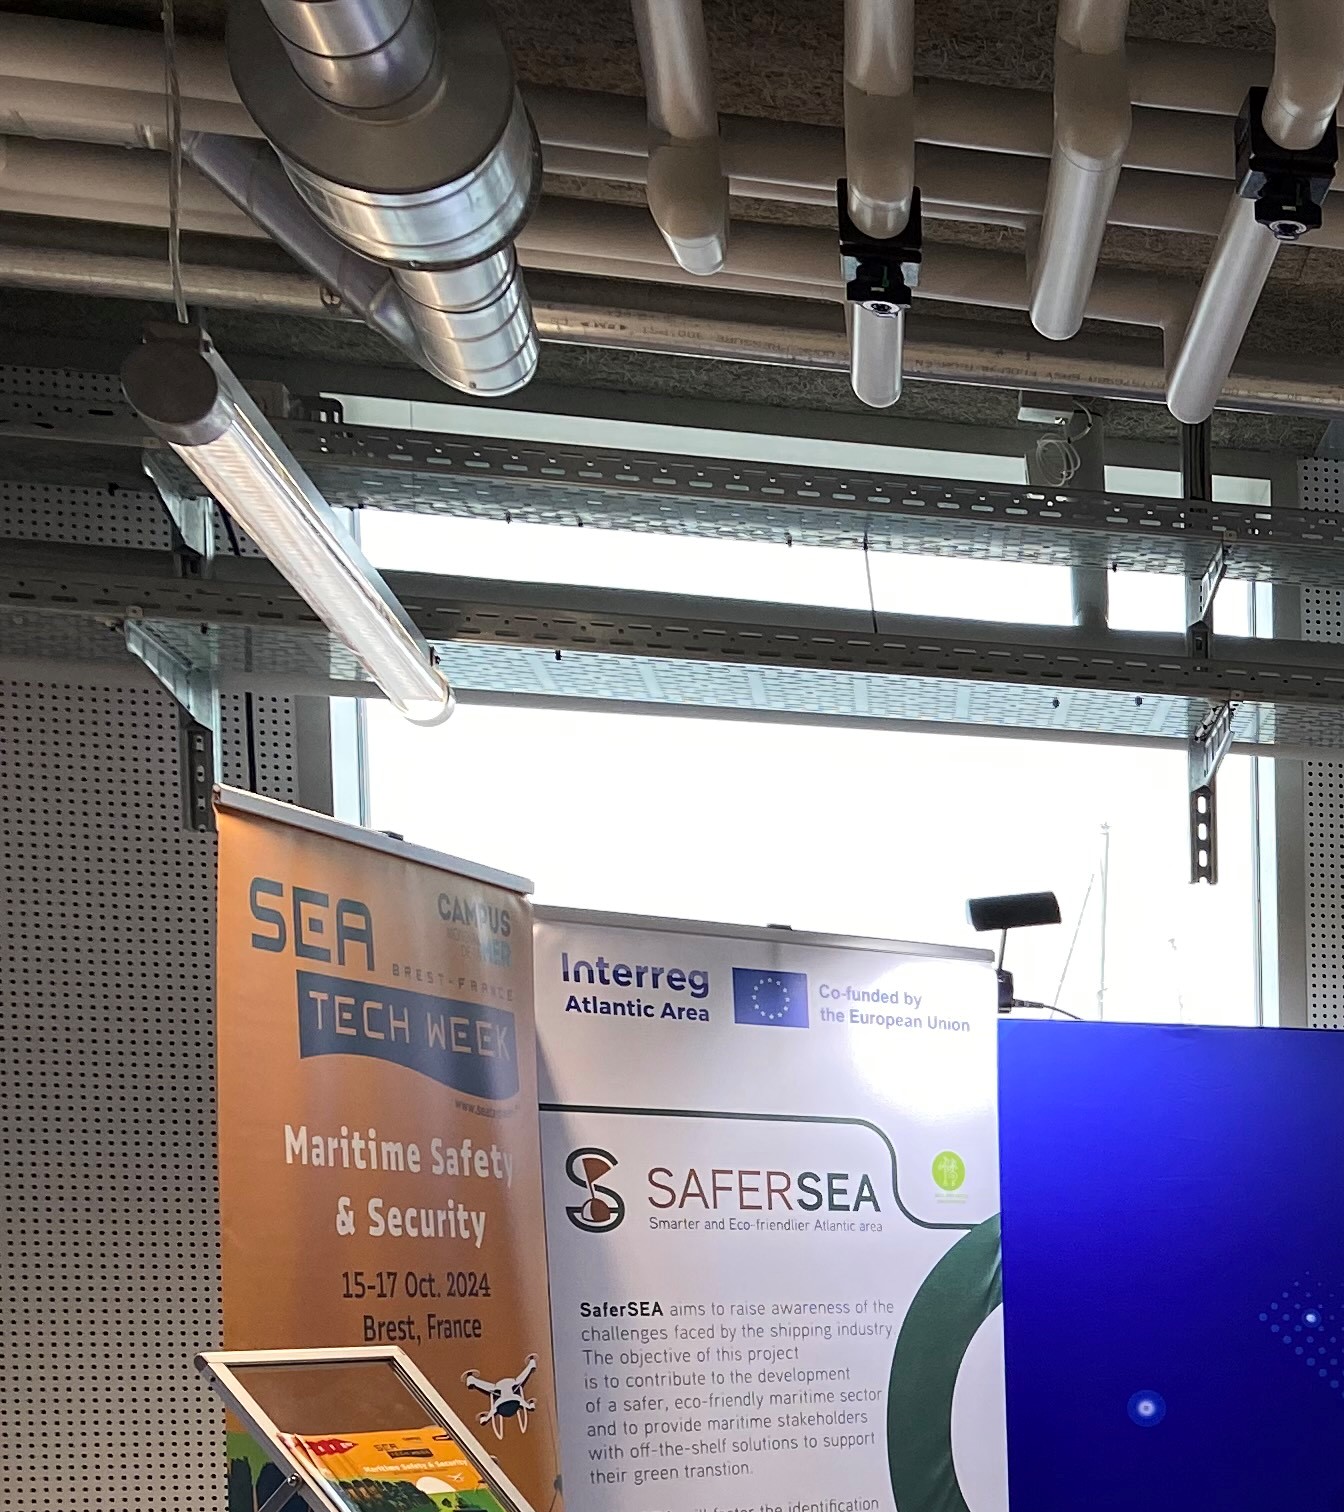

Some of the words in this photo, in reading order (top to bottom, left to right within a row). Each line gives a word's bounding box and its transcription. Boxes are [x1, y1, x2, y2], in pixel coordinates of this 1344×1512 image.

[249, 877, 375, 972] SEA
[562, 952, 709, 999] Interreg
[565, 995, 655, 1017] Atlantic
[660, 1002, 709, 1022] Area
[819, 984, 899, 1004] Co-funded
[904, 992, 922, 1010] by
[309, 991, 409, 1043] TECH
[427, 1012, 510, 1061] WEEK
[820, 1007, 845, 1023] the
[849, 1009, 922, 1029] European
[928, 1016, 970, 1032] Union
[285, 1124, 421, 1173] Maritime
[431, 1138, 511, 1188] Safety
[648, 1167, 881, 1212] SAFERSEA
[336, 1196, 355, 1235] &
[368, 1198, 486, 1249] Security
[649, 1216, 700, 1230] Smarter
[704, 1218, 725, 1230] and
[729, 1217, 810, 1231] Eco-friendlier
[814, 1219, 855, 1231] Atlantic
[859, 1223, 883, 1232] area
[342, 1271, 397, 1299] 15-17
[405, 1271, 441, 1298] Oct.
[447, 1271, 491, 1298] 2024
[580, 1301, 664, 1317] SaferSEA
[670, 1305, 706, 1316] aims
[711, 1302, 724, 1316] to
[730, 1304, 765, 1316] raise
[771, 1303, 850, 1315] awareness
[855, 1299, 868, 1314] of
[873, 1299, 894, 1314] the
[363, 1313, 421, 1346] Brest,
[427, 1313, 482, 1339] France
[581, 1326, 668, 1344] challenges
[674, 1324, 715, 1340] faced
[720, 1324, 736, 1342] by
[741, 1323, 764, 1338] the
[770, 1323, 832, 1340] shipping
[837, 1322, 896, 1339] industry.
[582, 1349, 613, 1365] The
[620, 1349, 691, 1368] objective
[697, 1347, 710, 1362] of
[716, 1346, 742, 1361] this
[748, 1346, 798, 1364] project
[585, 1377, 598, 1389] is
[604, 1375, 619, 1388] to
[626, 1371, 706, 1388] contribute
[711, 1371, 725, 1385] to
[730, 1369, 752, 1384] the
[758, 1367, 850, 1385] development
[586, 1397, 601, 1413] of
[608, 1401, 617, 1412] a
[623, 1395, 668, 1412] safer,
[674, 1391, 764, 1410] eco-friendly
[770, 1391, 834, 1405] maritime
[840, 1388, 882, 1402] sector
[587, 1420, 616, 1437] and
[623, 1421, 638, 1435] to
[644, 1417, 702, 1438] provide
[707, 1416, 772, 1430] maritime
[777, 1410, 868, 1427] stakeholders
[588, 1444, 624, 1460] with
[630, 1438, 726, 1458] off-the-shelf
[732, 1437, 798, 1452] solutions
[804, 1435, 817, 1448] to
[823, 1432, 874, 1449] support
[590, 1469, 627, 1484] their
[634, 1468, 679, 1485] green
